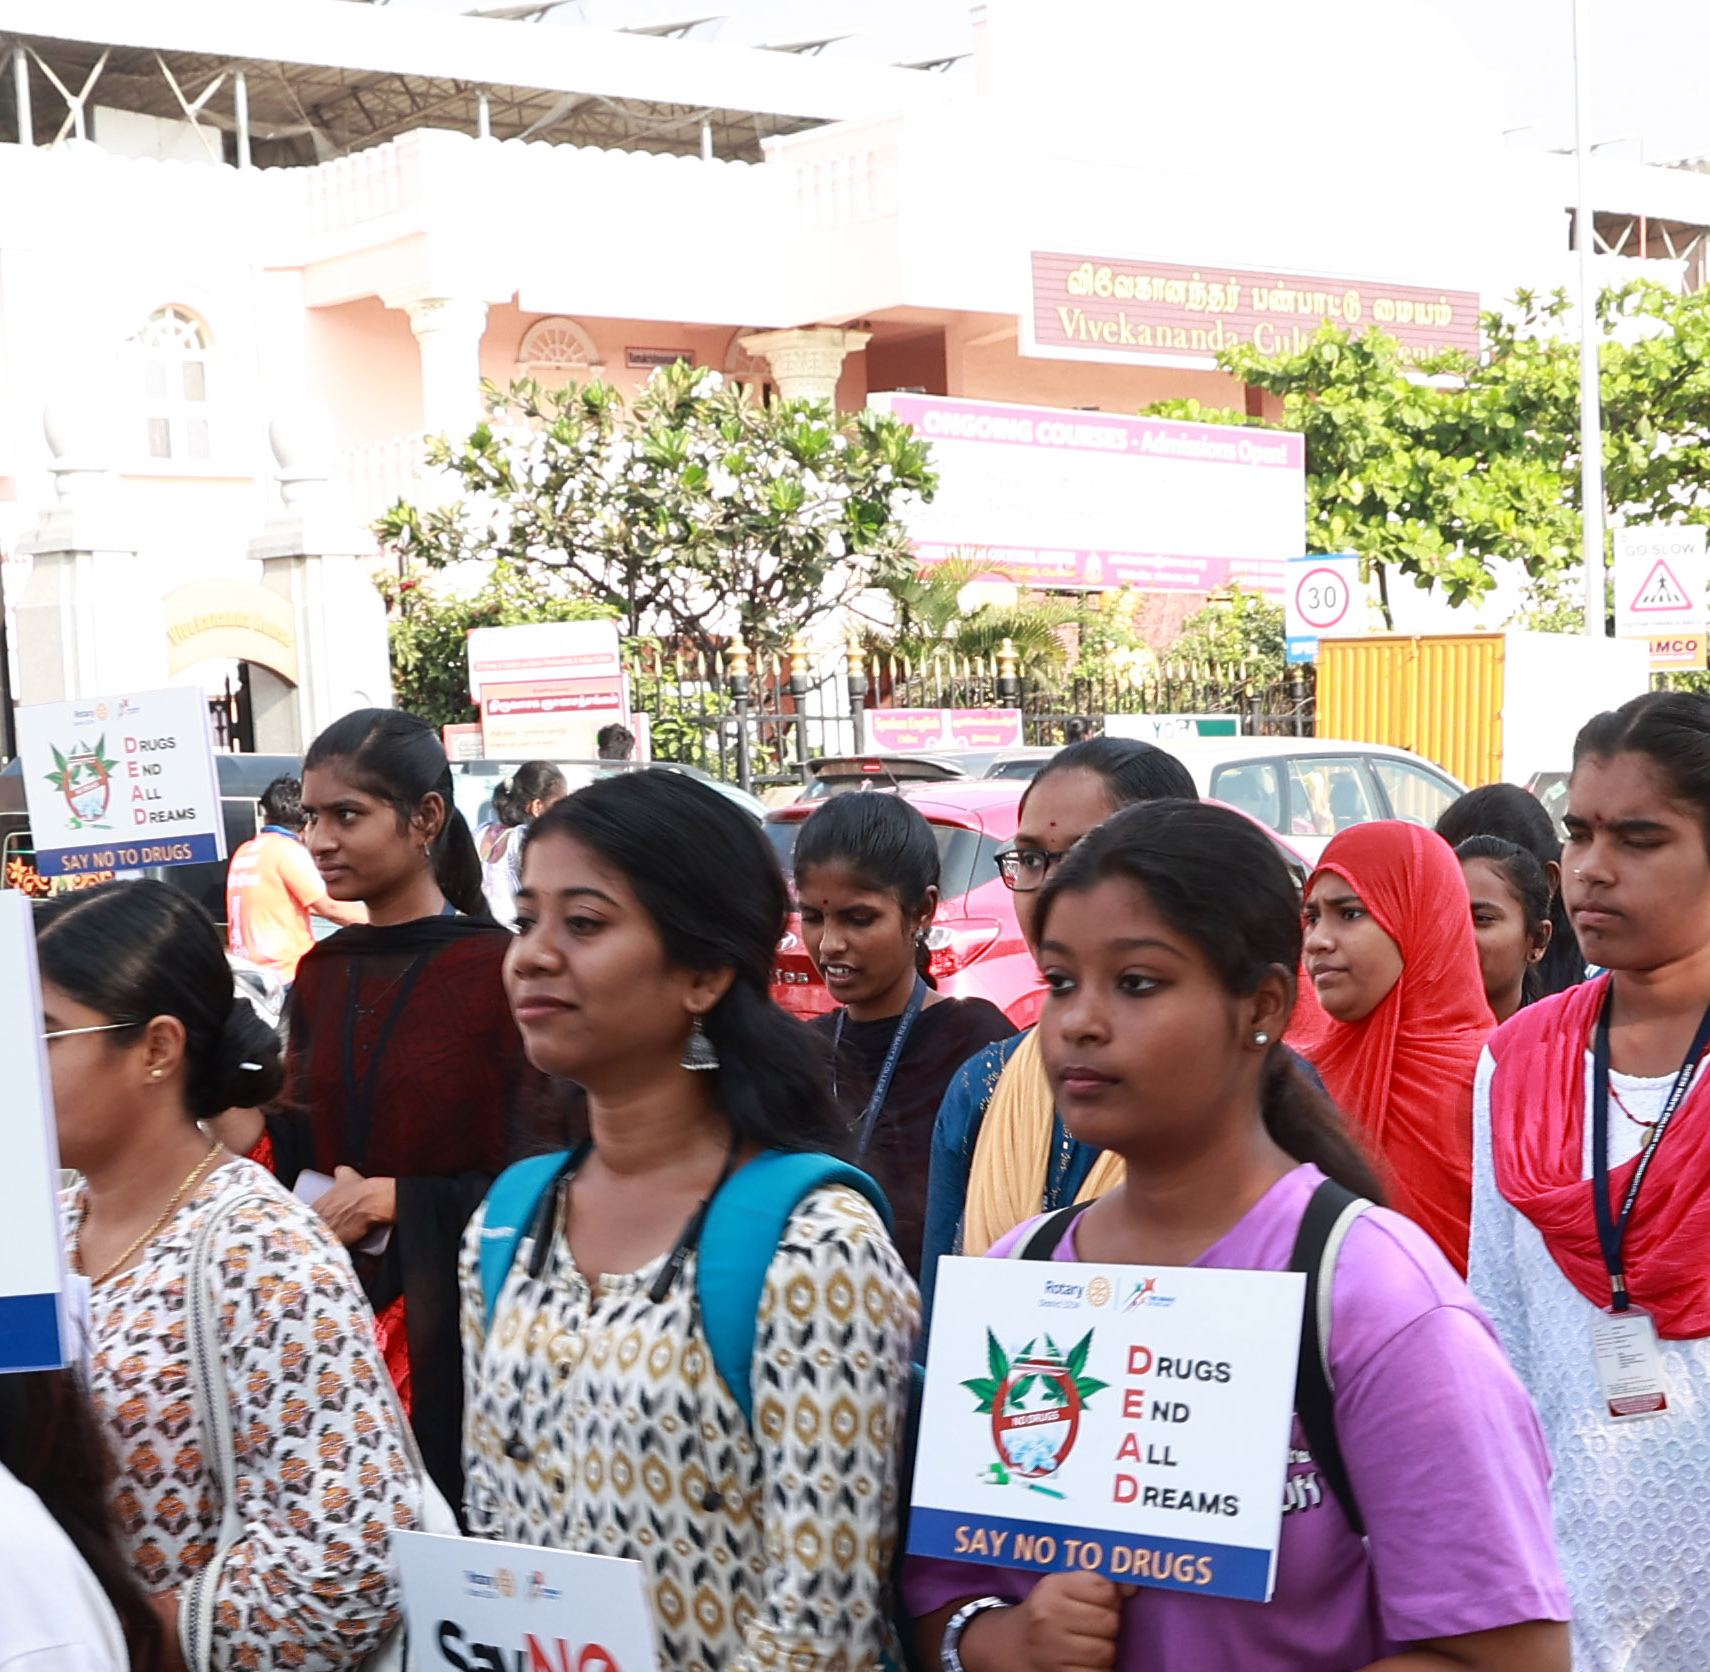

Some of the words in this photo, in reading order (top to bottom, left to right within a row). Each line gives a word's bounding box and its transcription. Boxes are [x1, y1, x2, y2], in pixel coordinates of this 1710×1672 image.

[1252, 280, 1361, 323] பண்பாட்டு
[1373, 295, 1454, 327] மையம்
[1058, 307, 1238, 352] Vivekananda
[923, 410, 1033, 442] ONGOING
[1037, 420, 1128, 450] COURSES
[1141, 433, 1236, 462] Admissions
[1237, 439, 1288, 468] Open!
[1625, 545, 1648, 557] GO
[1652, 543, 1696, 556] SLOW
[1308, 586, 1337, 610] 30
[124, 737, 177, 754] DRUGS
[127, 760, 163, 778] END
[131, 785, 162, 802] ALL
[134, 808, 196, 825] DREAMS
[60, 853, 89, 872] SAY
[93, 851, 115, 868] NO
[117, 848, 139, 865] TO
[141, 843, 193, 862] DRUGS
[1043, 1281, 1085, 1299] Rotary
[1126, 1345, 1232, 1383] DRUGS
[1122, 1389, 1190, 1424] END
[1116, 1433, 1178, 1467] ALL
[1113, 1474, 1240, 1517] DREAMS
[953, 1525, 1008, 1558] SAY
[1012, 1531, 1056, 1563] NO
[1064, 1540, 1103, 1570] TO
[1110, 1545, 1213, 1585] DRUGS
